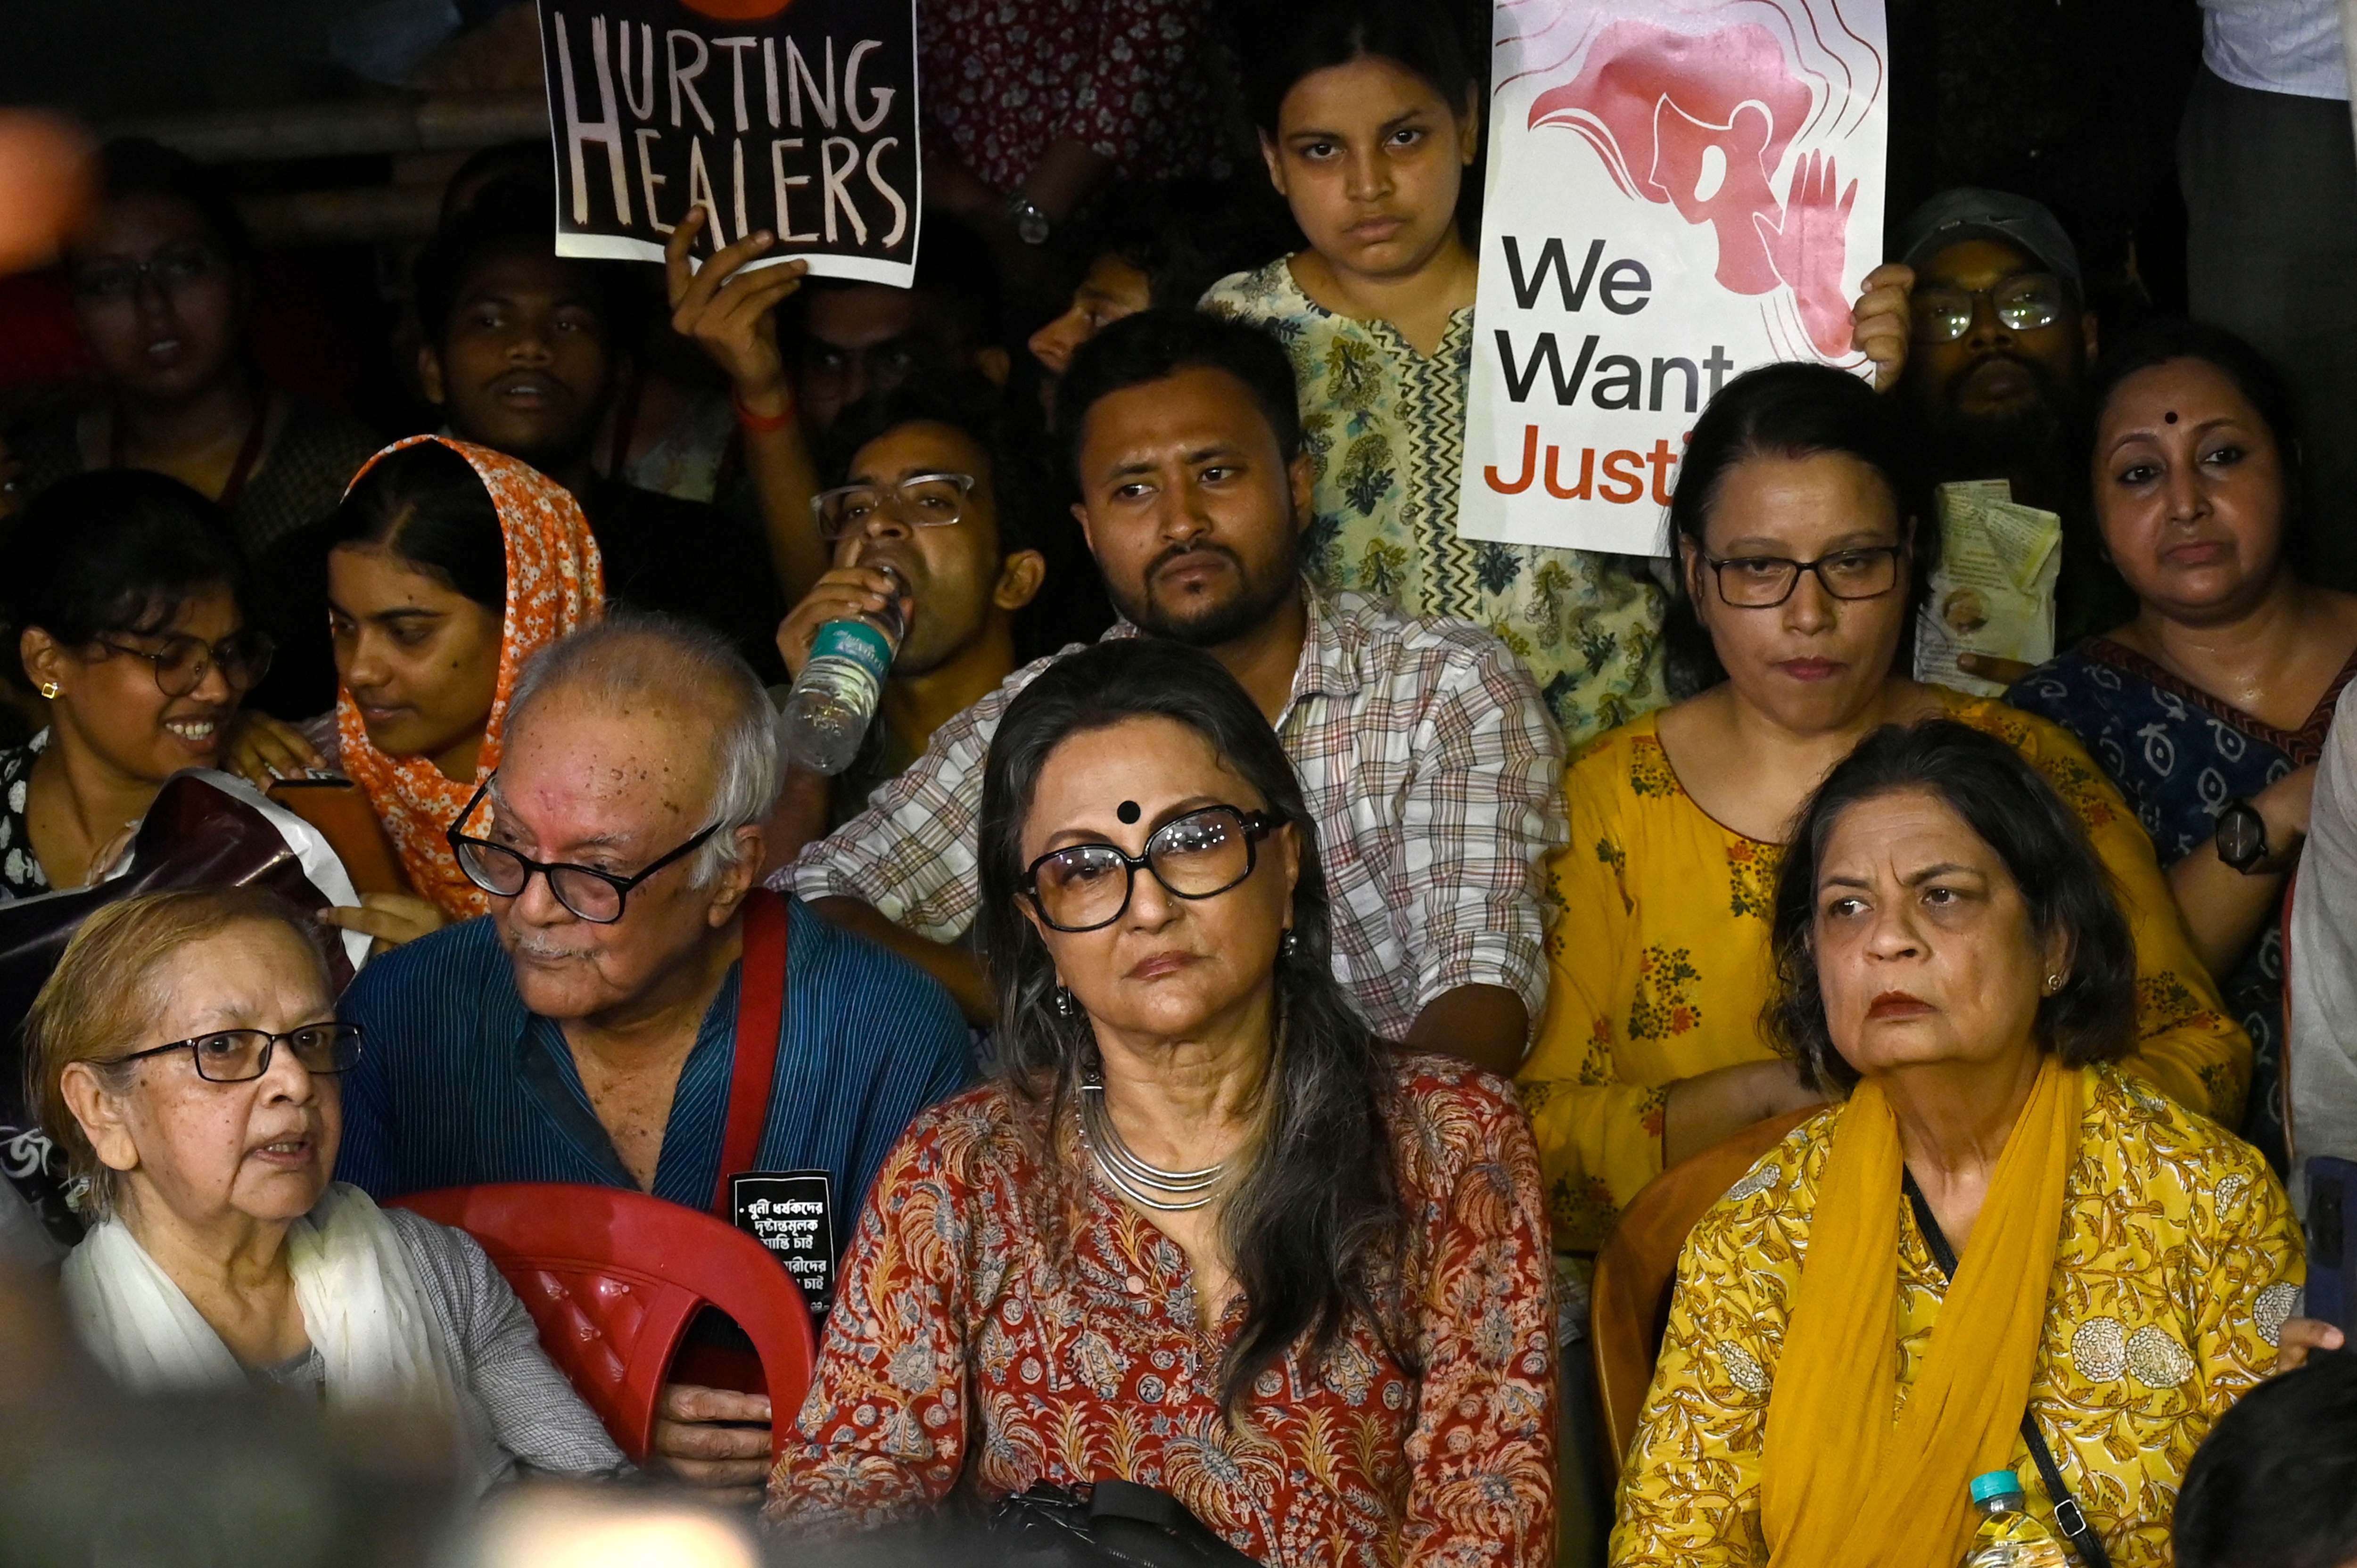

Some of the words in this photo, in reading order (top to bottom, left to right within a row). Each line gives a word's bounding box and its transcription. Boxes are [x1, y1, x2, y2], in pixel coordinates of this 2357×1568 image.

[554, 11, 896, 134] HURTING
[1502, 235, 1652, 315] We
[1494, 329, 1734, 412] Want
[1483, 424, 1693, 507] Just
[748, 1199, 770, 1220] খুনী
[773, 1199, 823, 1215] ধর্ষকদের
[754, 1218, 818, 1237] দৃষ্টান্তমূলক
[793, 1234, 813, 1249] চাই
[803, 1275, 824, 1290] চাই
